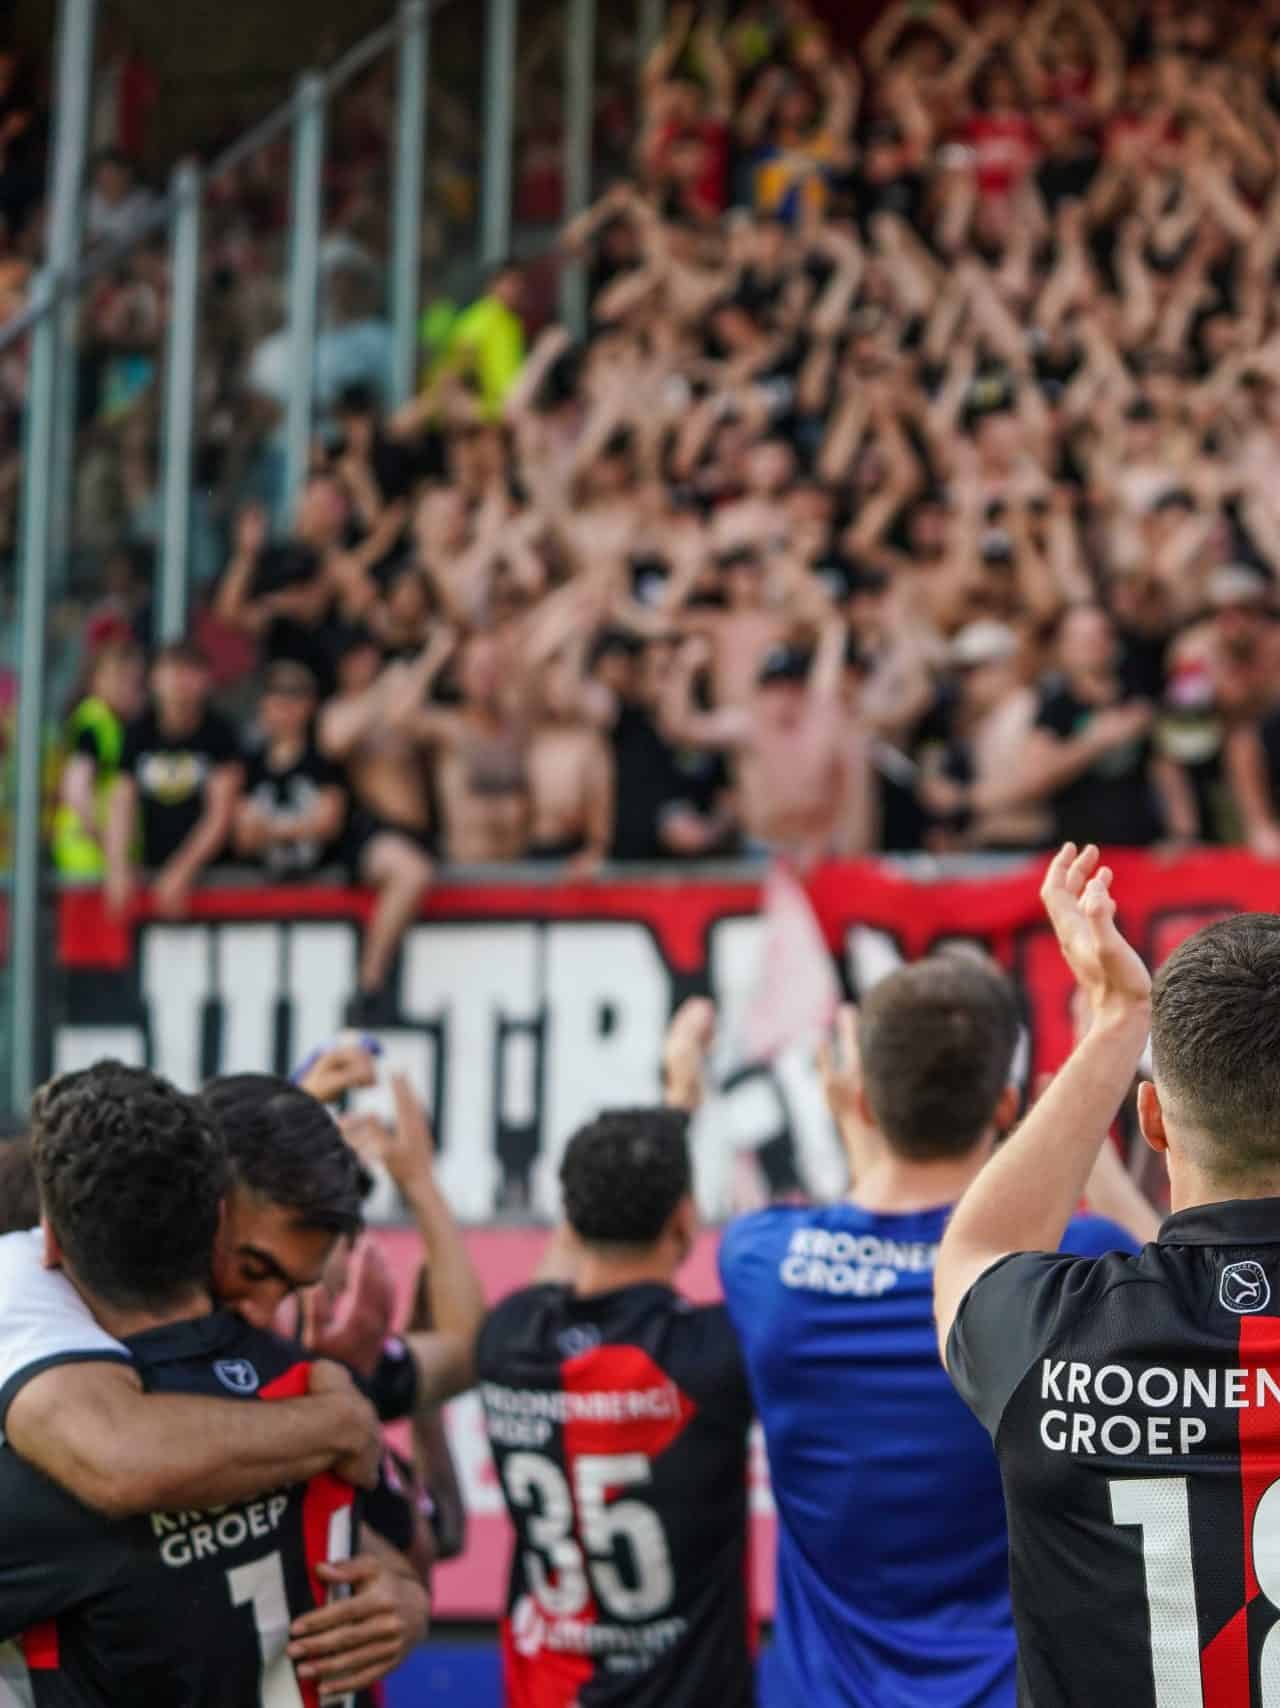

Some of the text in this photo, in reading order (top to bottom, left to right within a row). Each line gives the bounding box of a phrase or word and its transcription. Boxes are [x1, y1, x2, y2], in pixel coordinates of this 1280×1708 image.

[789, 1229, 937, 1272] KROONE
[780, 1255, 898, 1296] GROEP
[1039, 1409, 1207, 1456] GROEP
[160, 1495, 288, 1568] GROEP
[504, 1452, 675, 1621] 35
